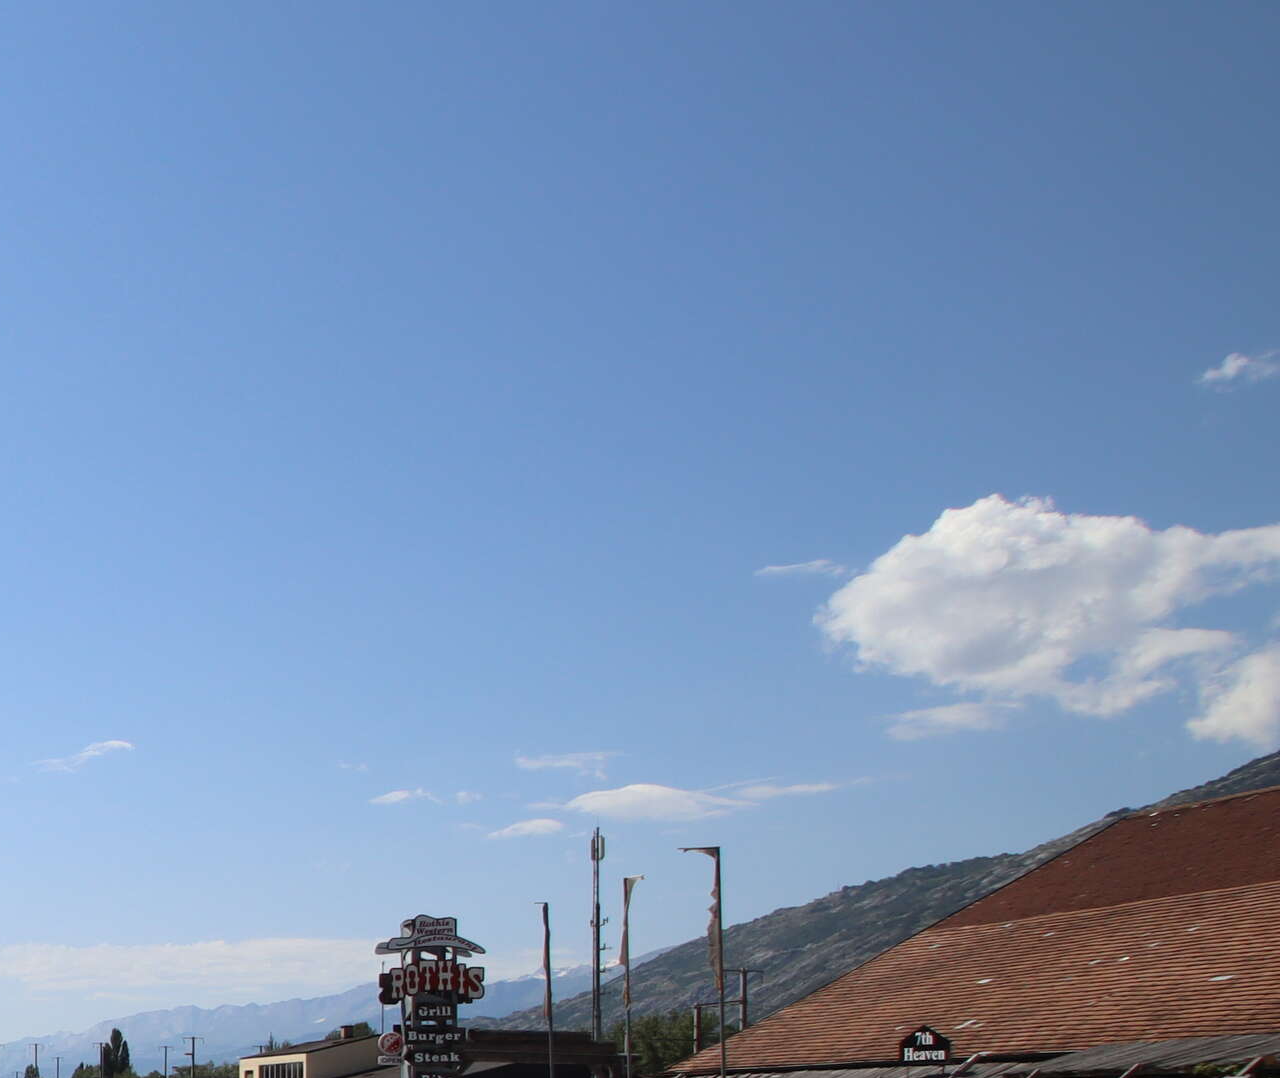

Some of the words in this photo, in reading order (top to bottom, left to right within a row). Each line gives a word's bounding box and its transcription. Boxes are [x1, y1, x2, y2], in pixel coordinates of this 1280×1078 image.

[416, 927, 453, 935] Western
[391, 960, 484, 999] ROTHIS
[418, 1006, 451, 1017] Grill
[408, 1031, 461, 1044] Burger
[915, 1031, 933, 1046] 7th
[414, 1052, 460, 1062] Steak
[903, 1047, 945, 1061] Heaven
